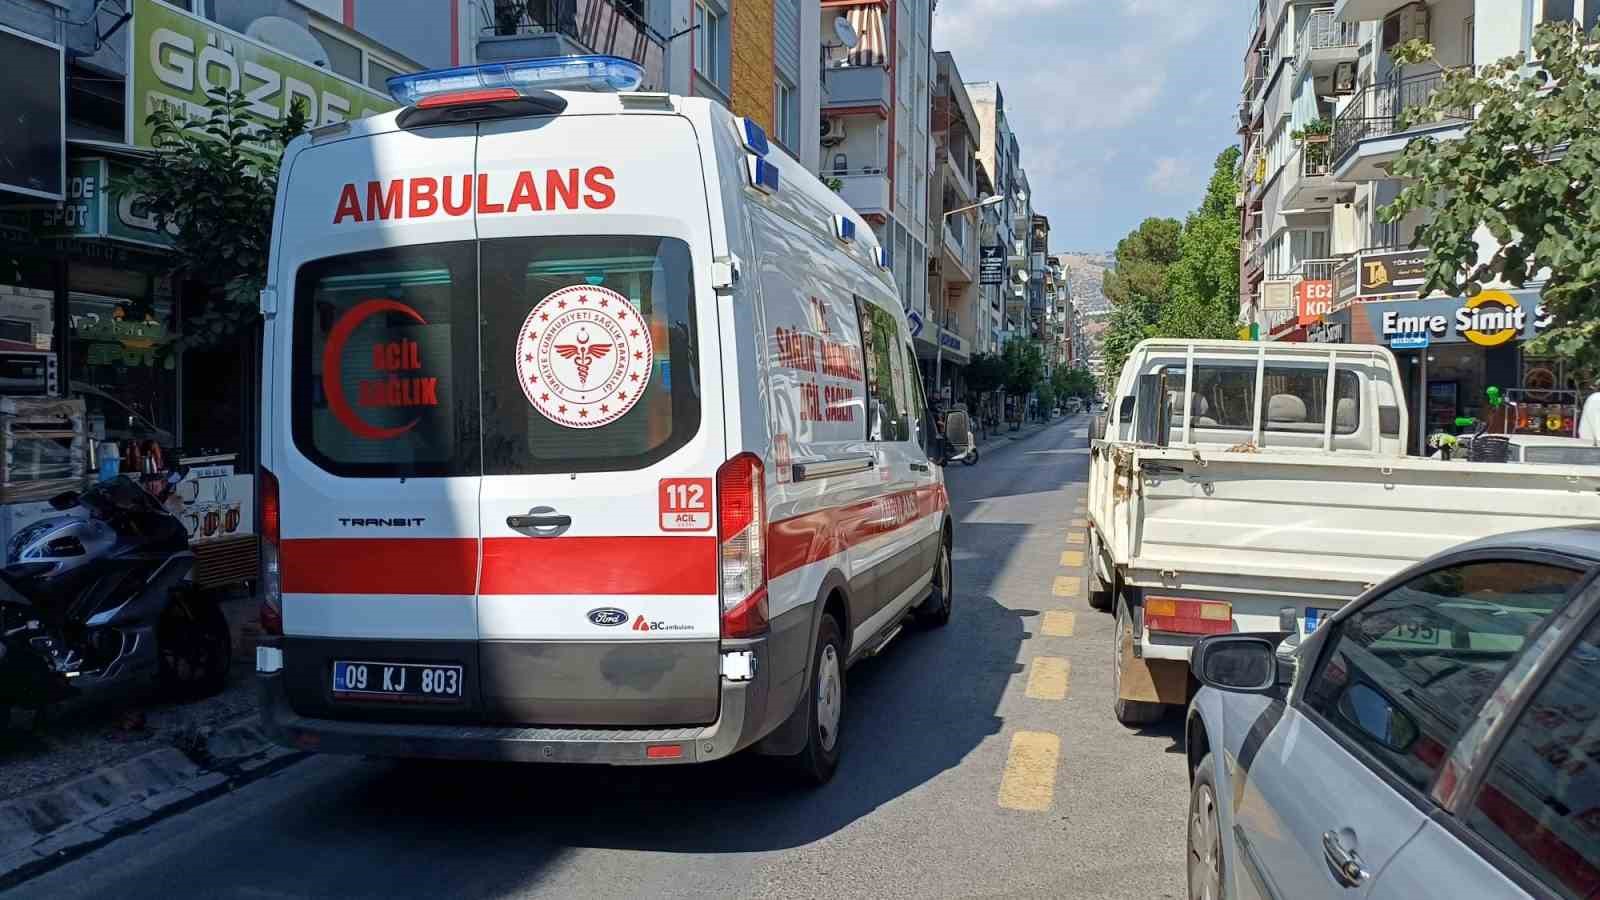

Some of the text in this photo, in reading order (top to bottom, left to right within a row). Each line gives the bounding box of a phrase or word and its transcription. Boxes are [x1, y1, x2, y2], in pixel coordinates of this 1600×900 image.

[151, 28, 350, 130] GÖZDE
[333, 165, 616, 224] AMBULANS
[594, 313, 621, 340] SAĞLIK
[1382, 311, 1446, 334] Emre
[1455, 305, 1525, 331] Simit
[666, 484, 704, 509] 112
[338, 517, 426, 527] TRANSIT
[345, 665, 457, 694] 09 KJ 803
